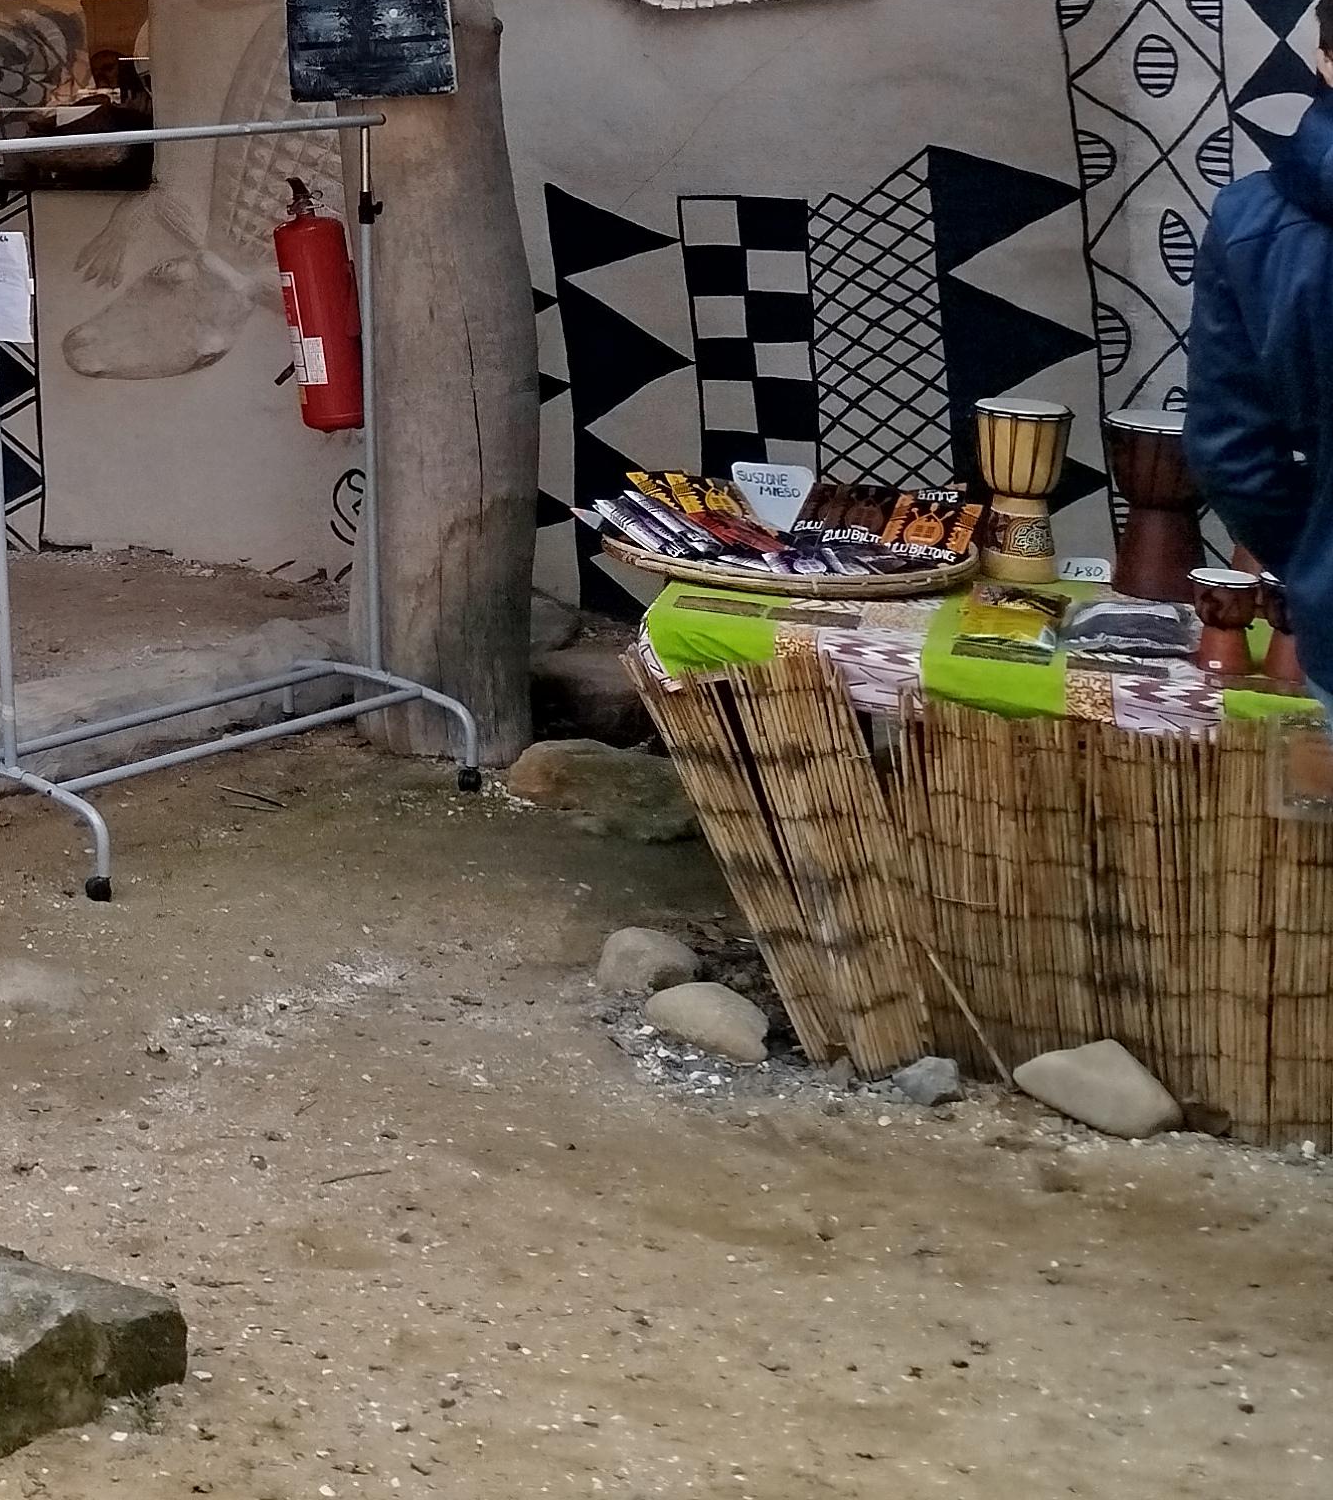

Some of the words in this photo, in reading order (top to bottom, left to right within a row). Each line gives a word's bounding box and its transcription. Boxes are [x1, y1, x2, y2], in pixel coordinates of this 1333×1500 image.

[737, 470, 788, 486] SUSZONE
[822, 529, 851, 543] ZULU
[909, 543, 957, 563] BILTONG
